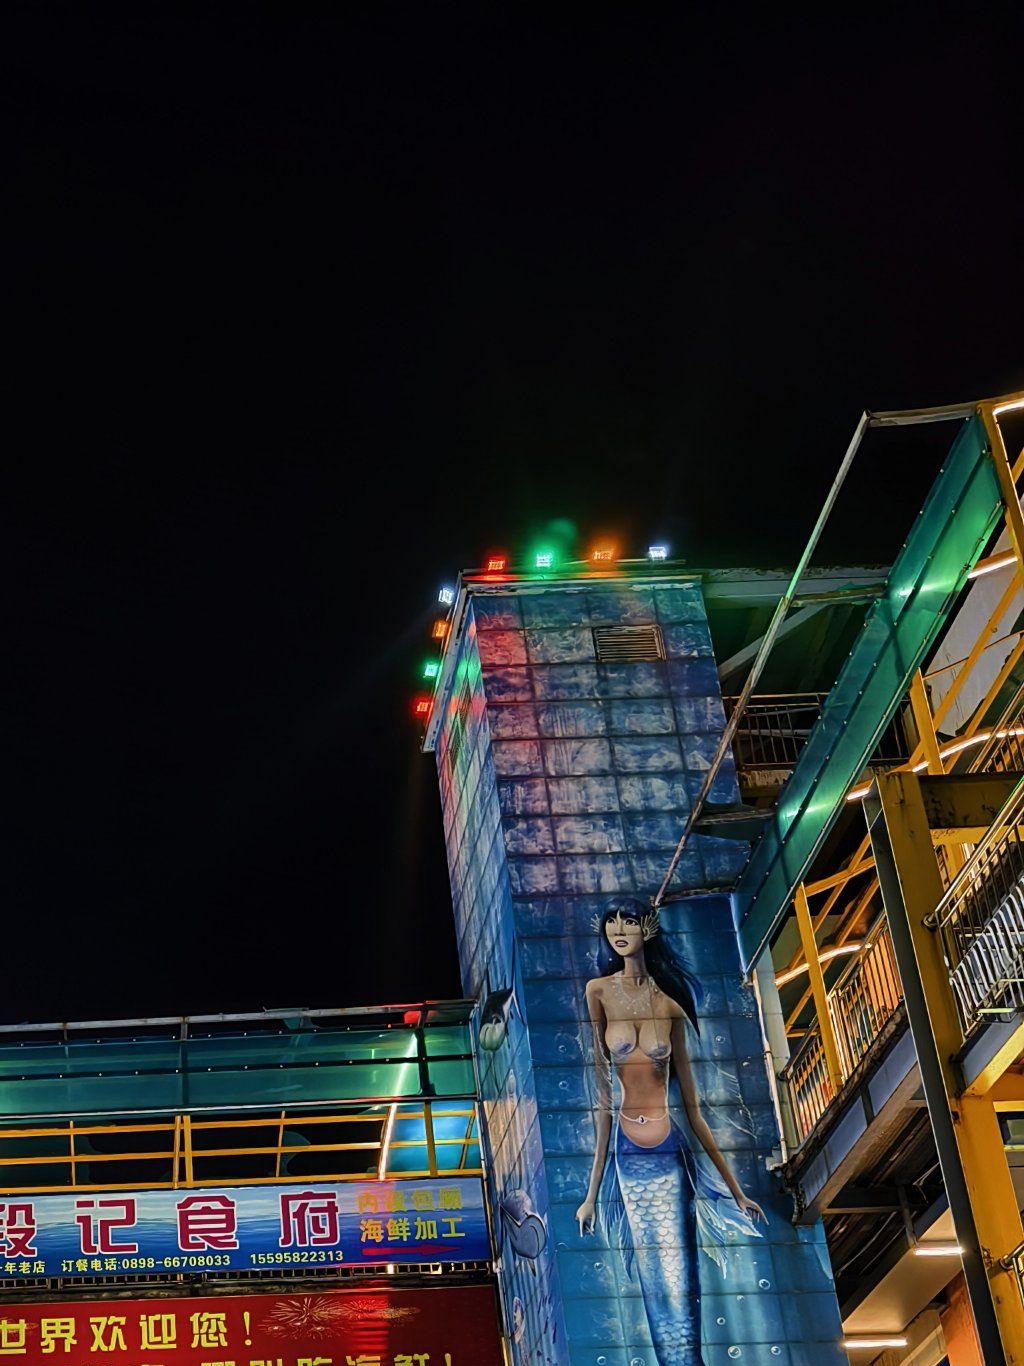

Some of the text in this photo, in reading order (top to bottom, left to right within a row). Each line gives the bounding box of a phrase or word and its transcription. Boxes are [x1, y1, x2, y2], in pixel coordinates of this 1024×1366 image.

[360, 1217, 465, 1243] 海鲜加工
[250, 1250, 344, 1265] 15595822313
